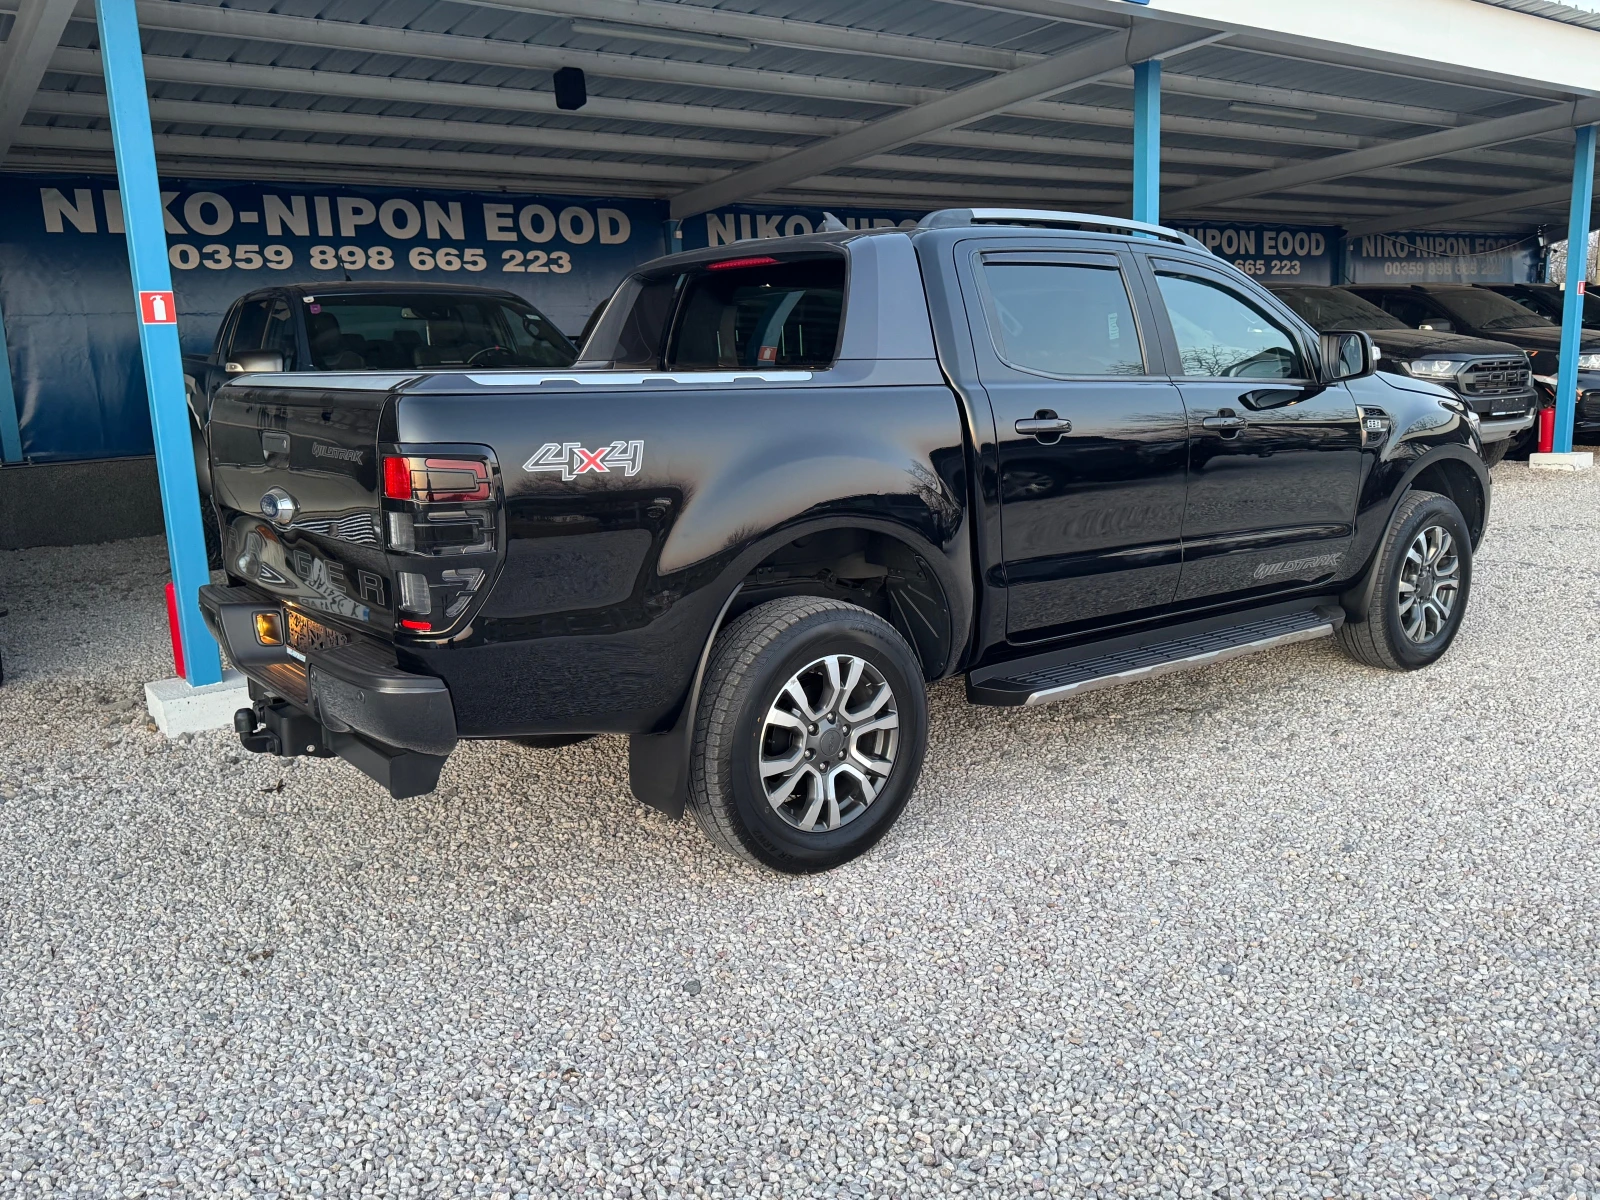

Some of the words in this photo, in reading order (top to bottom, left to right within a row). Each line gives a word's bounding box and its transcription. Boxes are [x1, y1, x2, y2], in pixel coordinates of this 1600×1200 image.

[483, 203, 632, 245] EOOD
[1263, 231, 1326, 257] EOOD
[1362, 234, 1472, 258] NIKO-NIPON
[309, 245, 395, 271] 898
[408, 246, 488, 272] 665
[501, 249, 572, 274] 223
[1270, 260, 1301, 275] 223
[1384, 261, 1425, 276] 00359
[312, 441, 364, 466] WILDTRAK
[225, 525, 385, 606] RANGER
[1253, 551, 1343, 579] WILDTRAK
